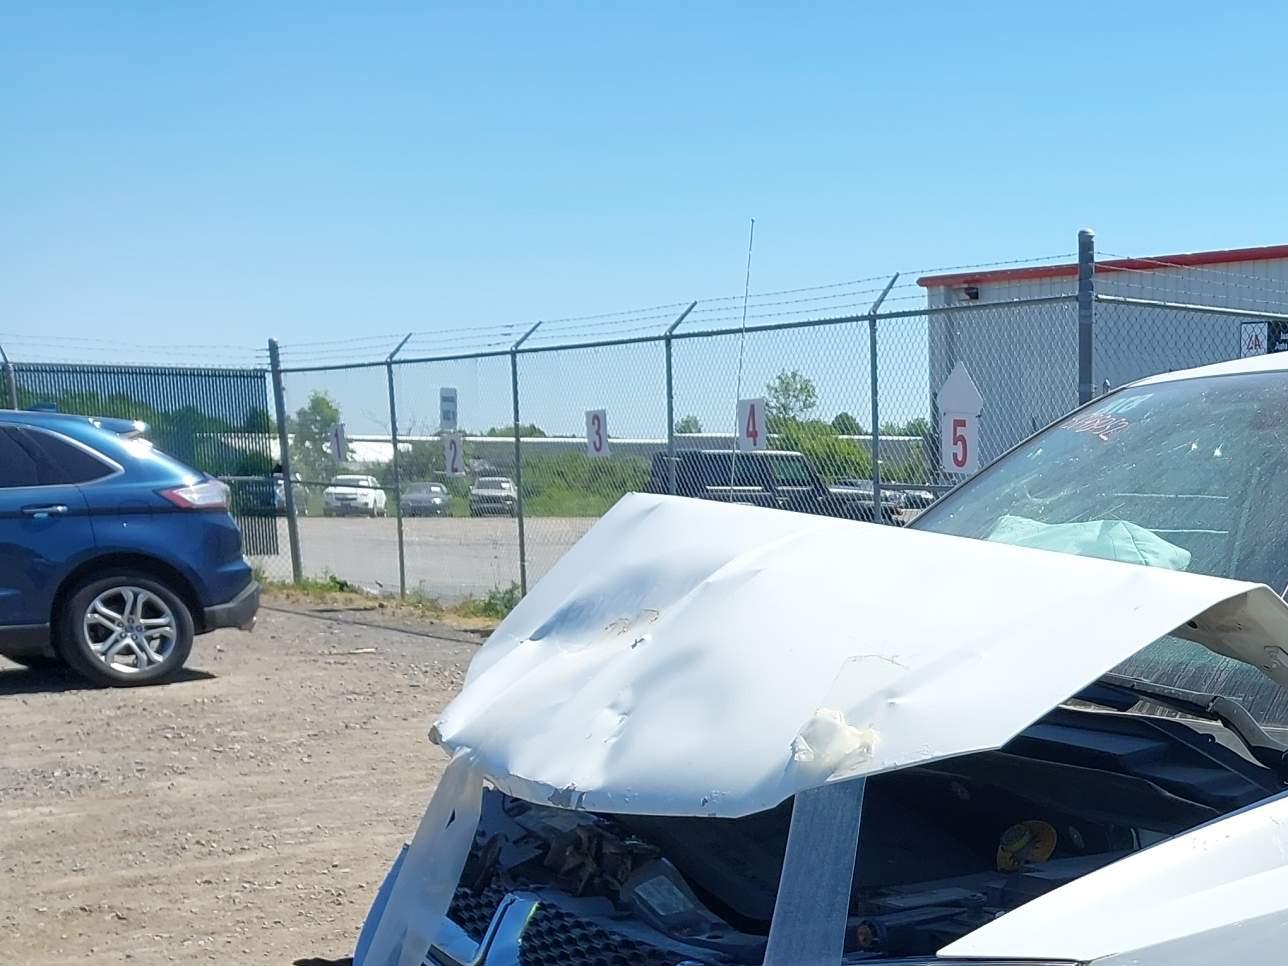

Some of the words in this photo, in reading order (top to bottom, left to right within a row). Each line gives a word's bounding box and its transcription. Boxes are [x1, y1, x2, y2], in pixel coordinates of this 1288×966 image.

[334, 428, 342, 460] 1
[591, 413, 603, 452] 3
[745, 403, 759, 447] 4
[952, 418, 968, 468] 5
[449, 438, 459, 473] 2
